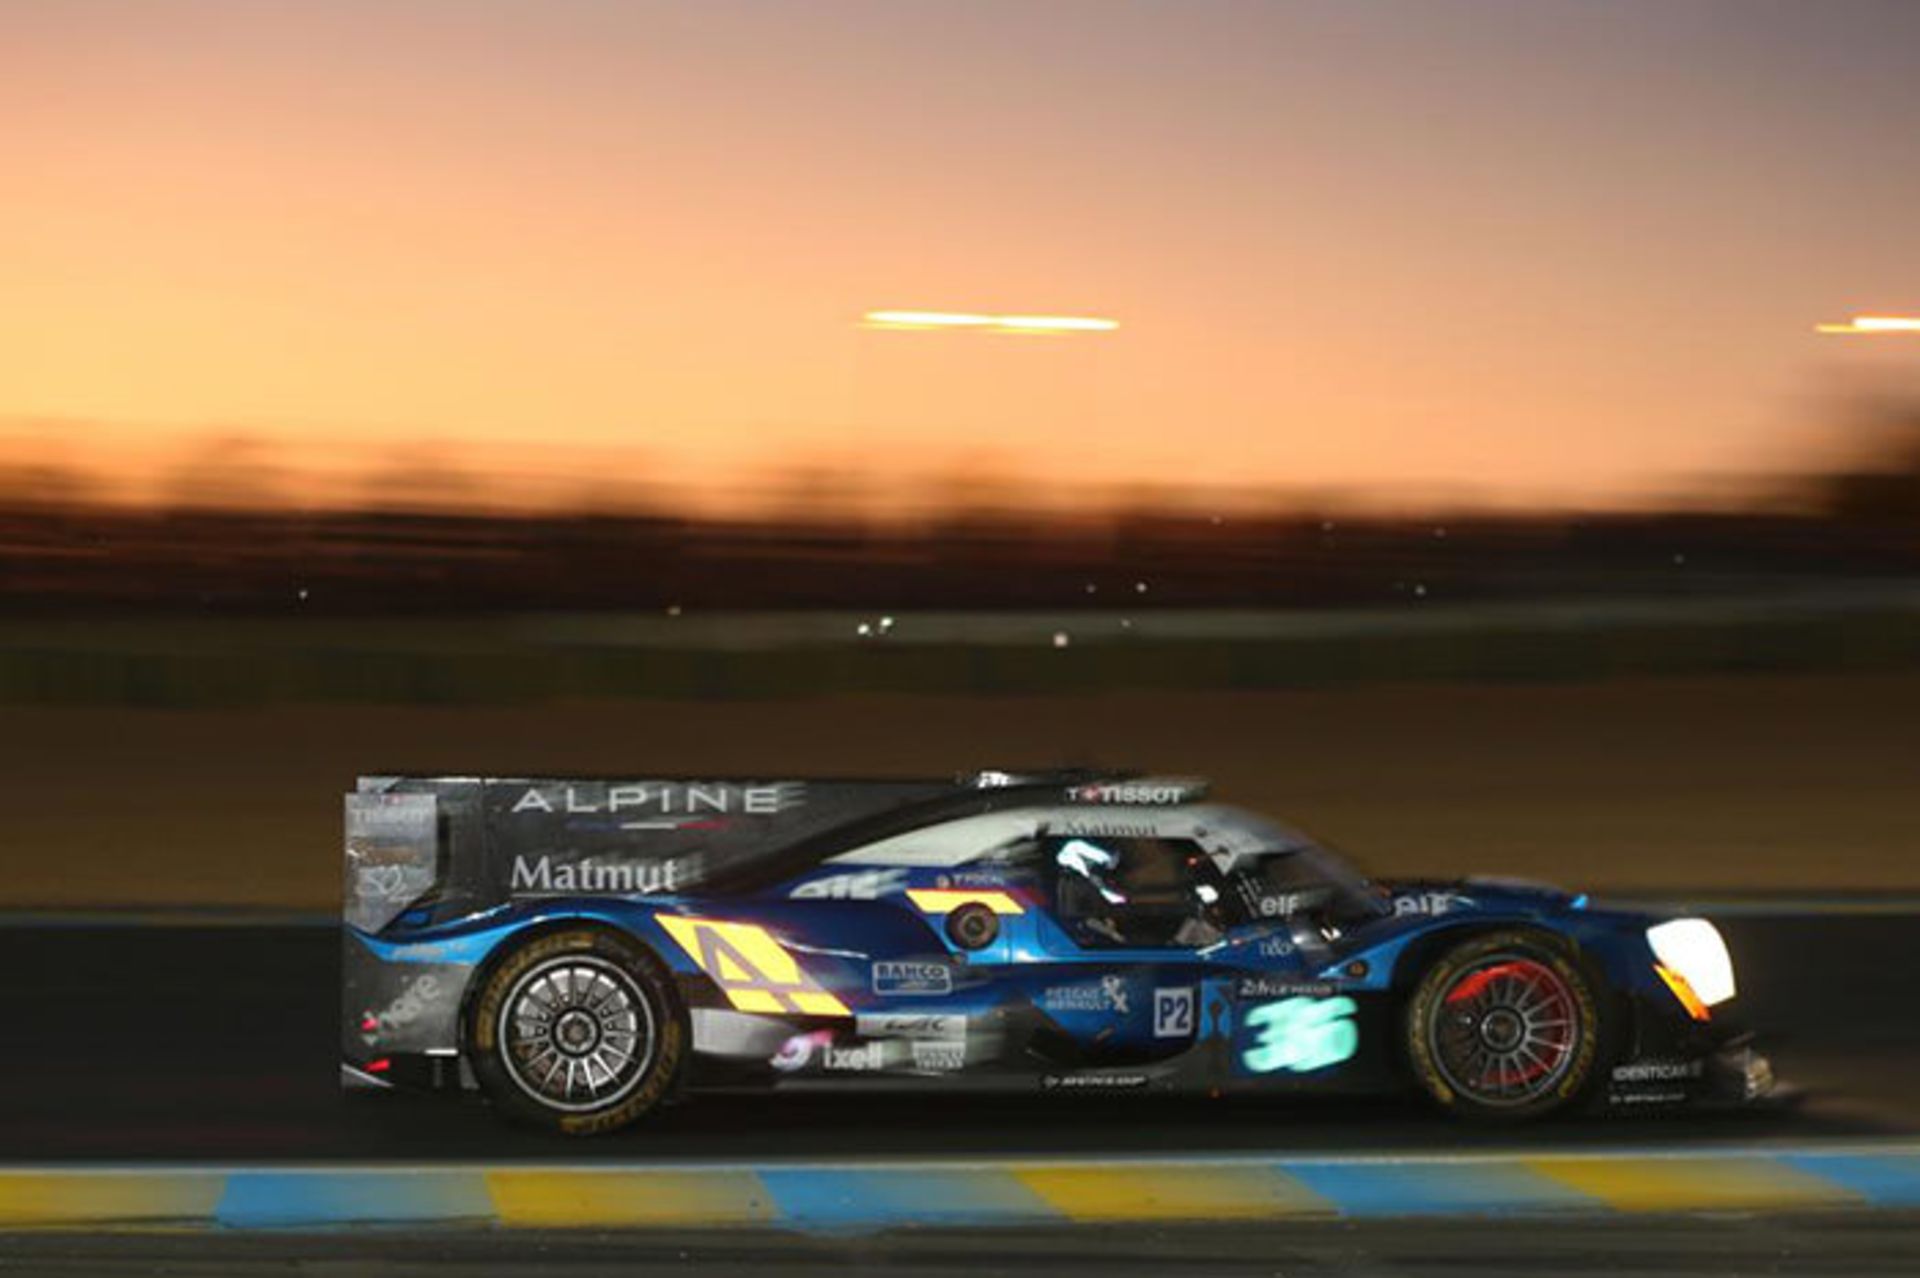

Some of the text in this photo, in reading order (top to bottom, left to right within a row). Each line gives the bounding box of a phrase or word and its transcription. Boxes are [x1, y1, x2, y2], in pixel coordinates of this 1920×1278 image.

[511, 786, 782, 813] ALPINE
[511, 855, 680, 892] Matmut
[1260, 896, 1299, 915] elf
[1159, 997, 1189, 1030] P2
[1242, 994, 1359, 1072] 36
